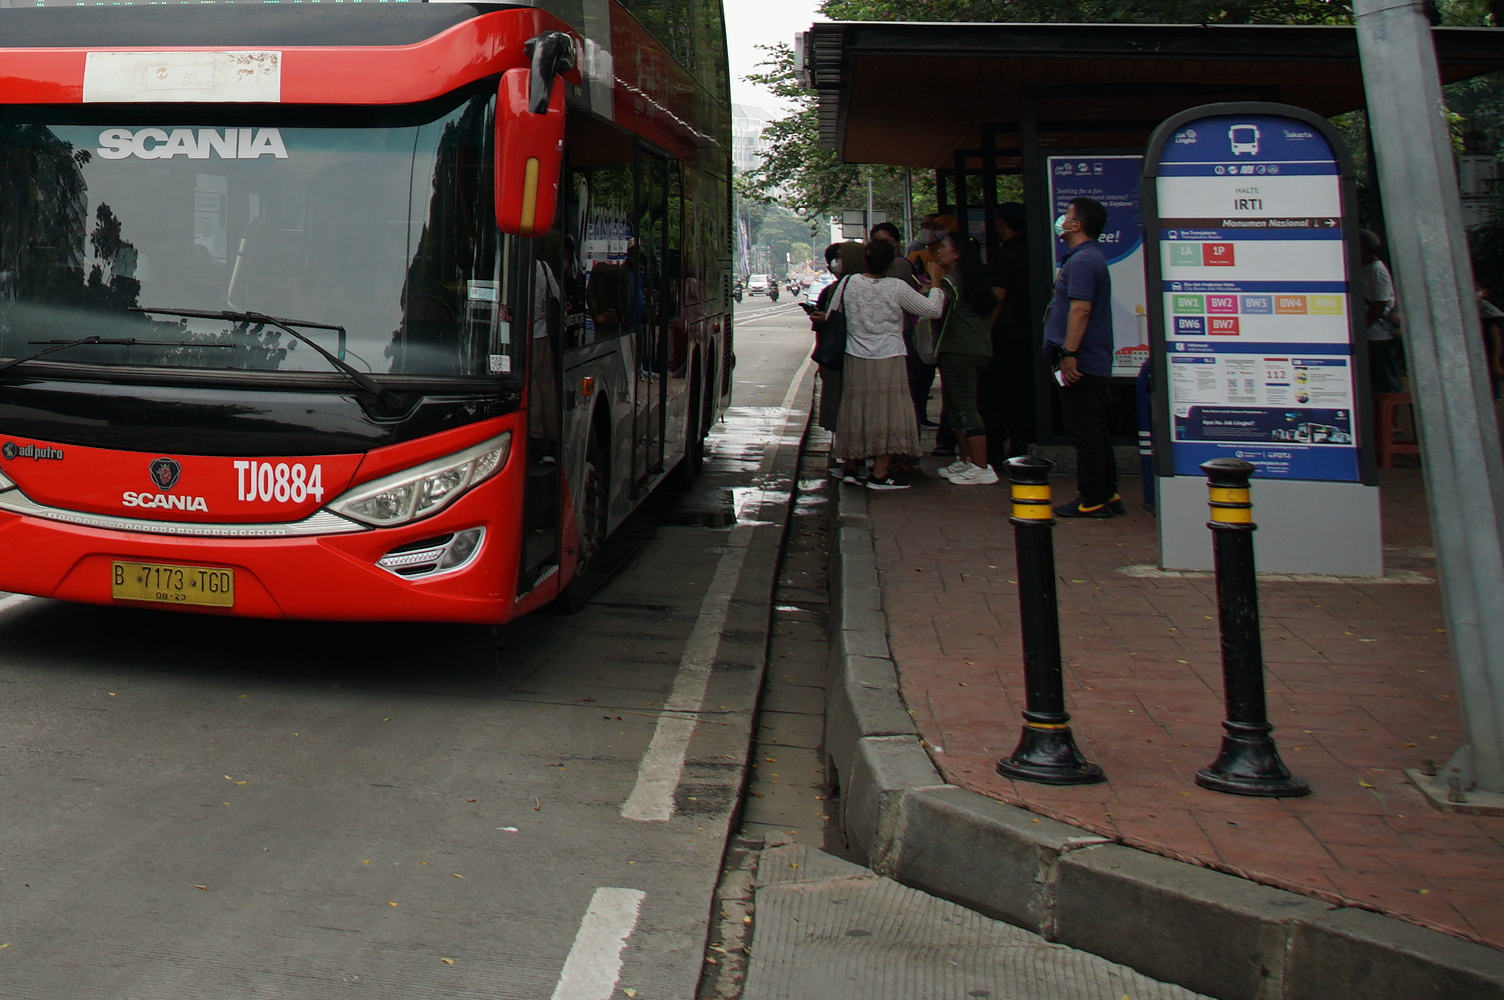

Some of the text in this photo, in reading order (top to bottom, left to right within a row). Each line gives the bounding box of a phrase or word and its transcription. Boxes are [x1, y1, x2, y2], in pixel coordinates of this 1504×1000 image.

[96, 128, 289, 160] SCANIA
[1234, 199, 1263, 210] IRTI
[1222, 218, 1309, 228] Monumen Nasional
[1180, 246, 1192, 256] 1A
[1212, 246, 1226, 256] 1P
[1178, 298, 1199, 307] BW1
[1212, 298, 1232, 307] BW2
[1246, 298, 1266, 307] BW3
[1280, 298, 1302, 307] BW4
[1178, 319, 1200, 329] BW6
[1212, 319, 1234, 329] BW7
[1267, 371, 1287, 379] 112
[233, 460, 324, 503] TJ0884
[121, 491, 209, 513] SCANIA
[114, 564, 231, 594] B 7173 TGD
